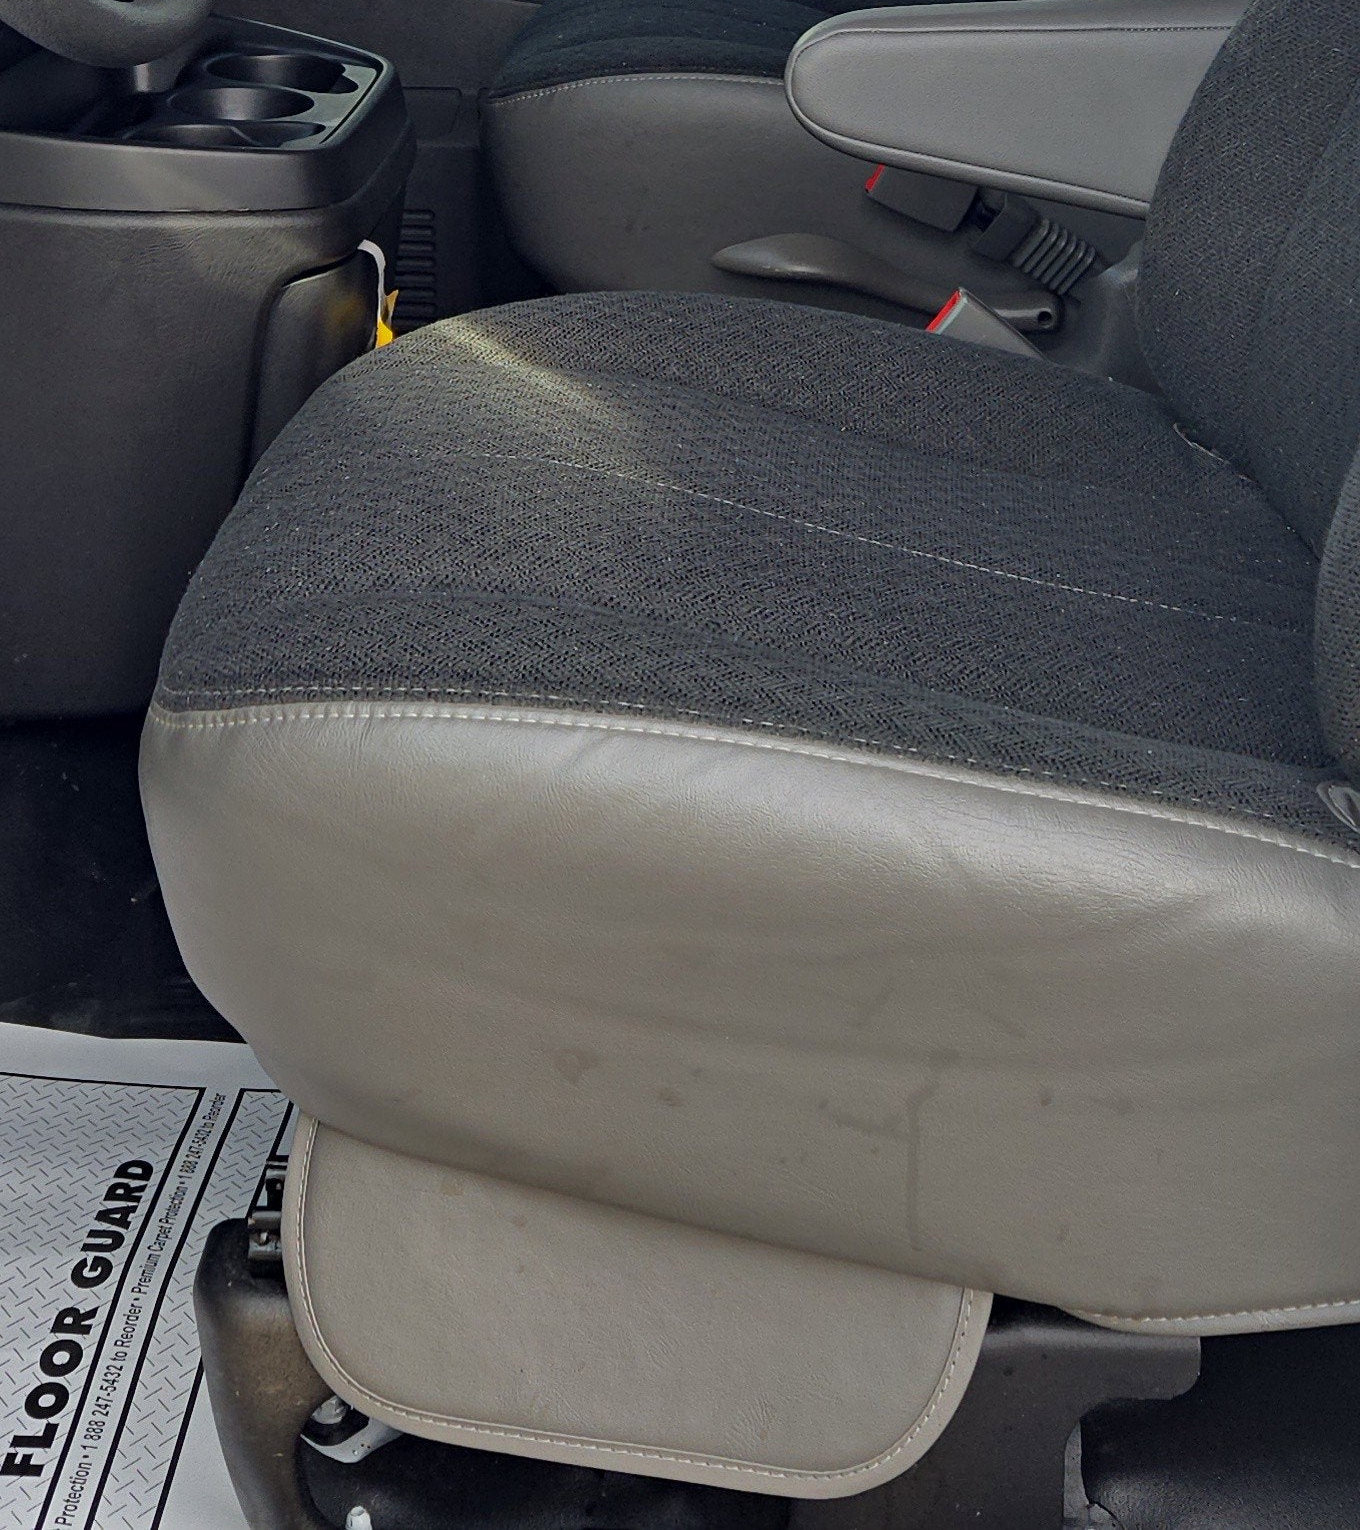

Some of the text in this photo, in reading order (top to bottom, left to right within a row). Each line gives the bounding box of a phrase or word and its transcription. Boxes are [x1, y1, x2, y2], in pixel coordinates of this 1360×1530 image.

[70, 1159, 154, 1289] GUARD
[159, 1186, 188, 1225] Protection
[147, 1225, 172, 1251] Carpet
[131, 1253, 162, 1296] Premium
[114, 1303, 143, 1357] Reorder
[111, 1350, 127, 1362] to
[92, 1364, 123, 1417] 247-5432
[86, 1420, 105, 1442] 888
[55, 1462, 92, 1526] Protection
